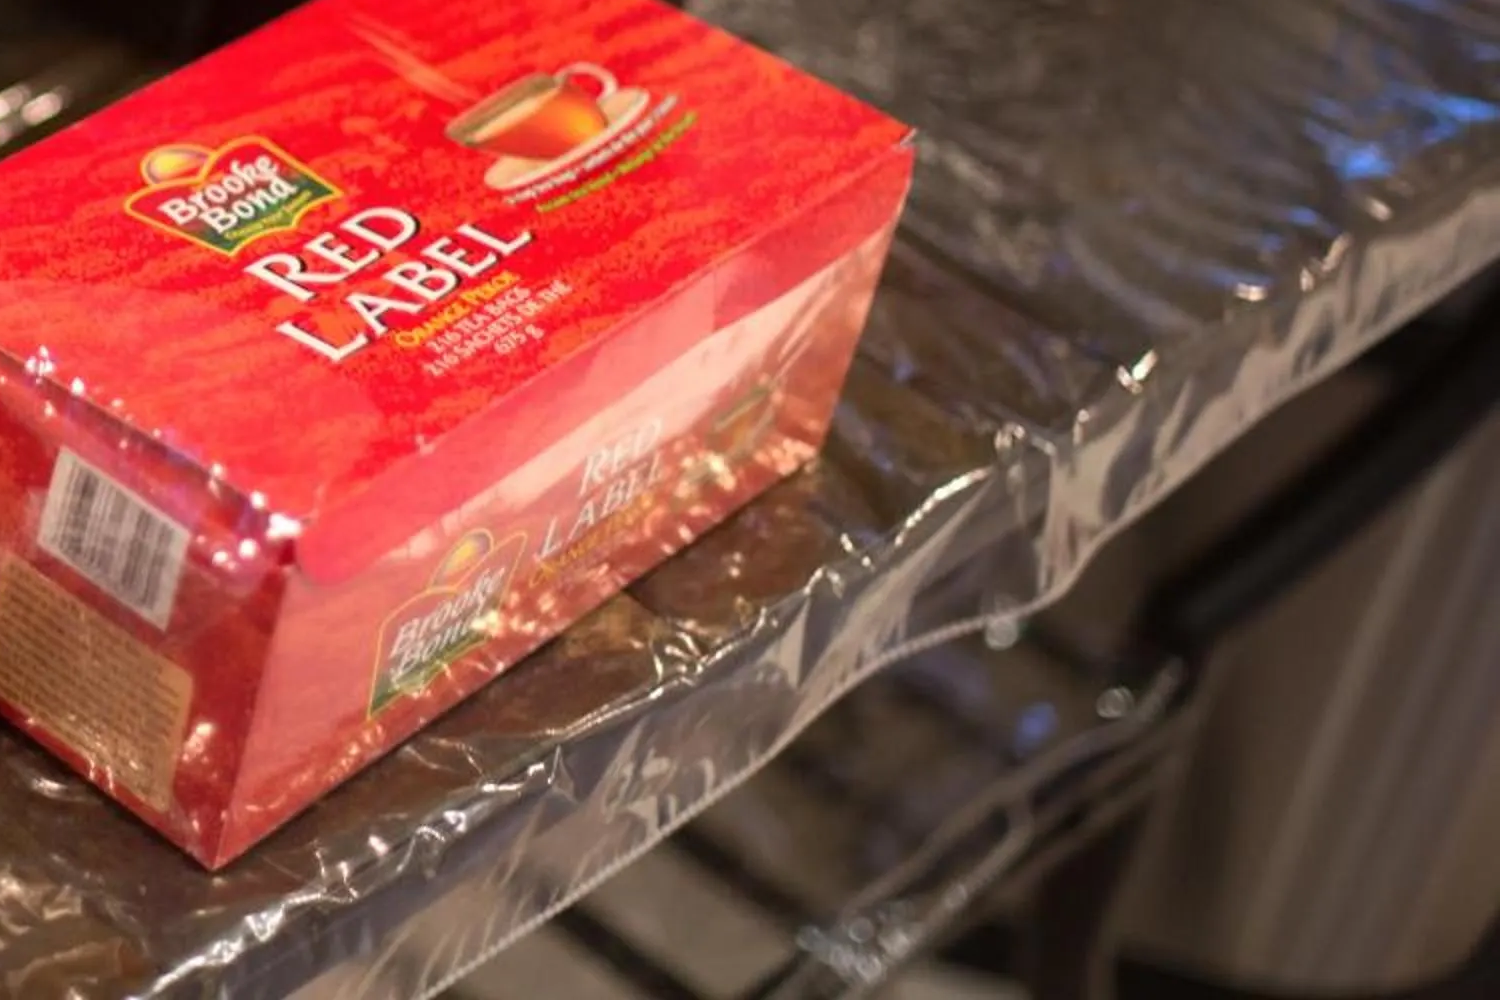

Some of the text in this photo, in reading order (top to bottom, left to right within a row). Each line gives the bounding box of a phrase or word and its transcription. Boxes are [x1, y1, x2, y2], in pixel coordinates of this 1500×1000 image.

[157, 154, 281, 226] Brooke
[199, 175, 299, 235] Bond
[243, 206, 419, 302] RED
[275, 222, 535, 362] LABEL
[577, 417, 663, 497] RED
[535, 451, 663, 565] LABEL
